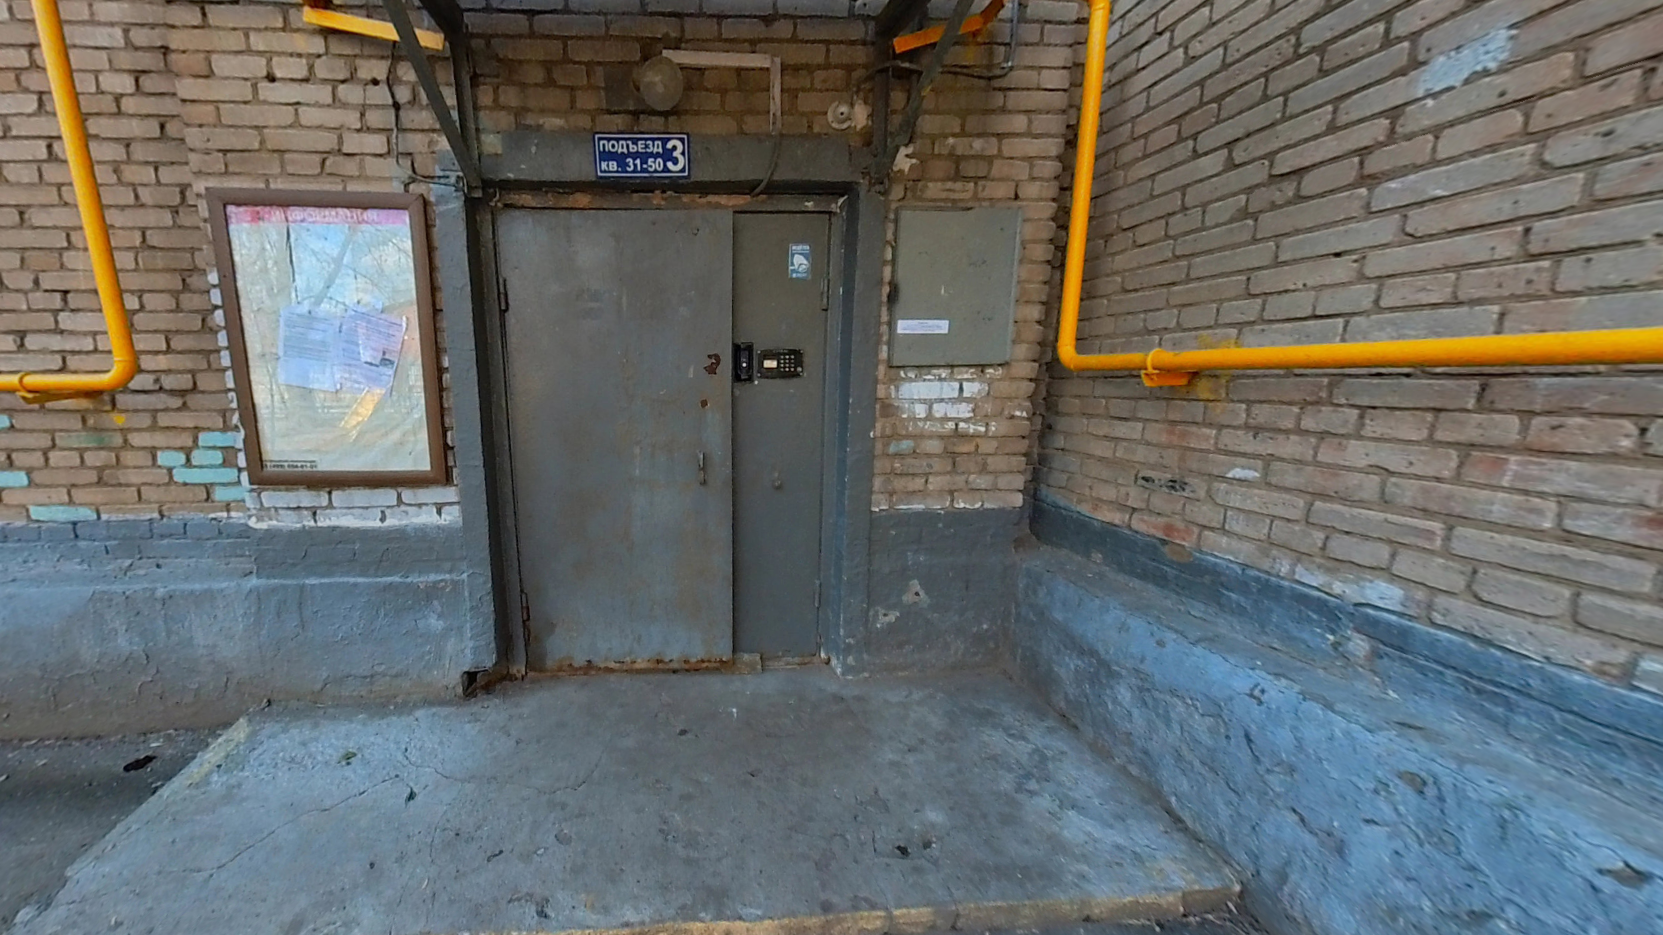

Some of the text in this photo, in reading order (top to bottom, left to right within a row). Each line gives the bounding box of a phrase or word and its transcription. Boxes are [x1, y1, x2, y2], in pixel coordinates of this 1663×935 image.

[600, 140, 663, 154] ПОДЪЕЗД
[665, 139, 685, 172] 3
[625, 157, 664, 172] 31-50
